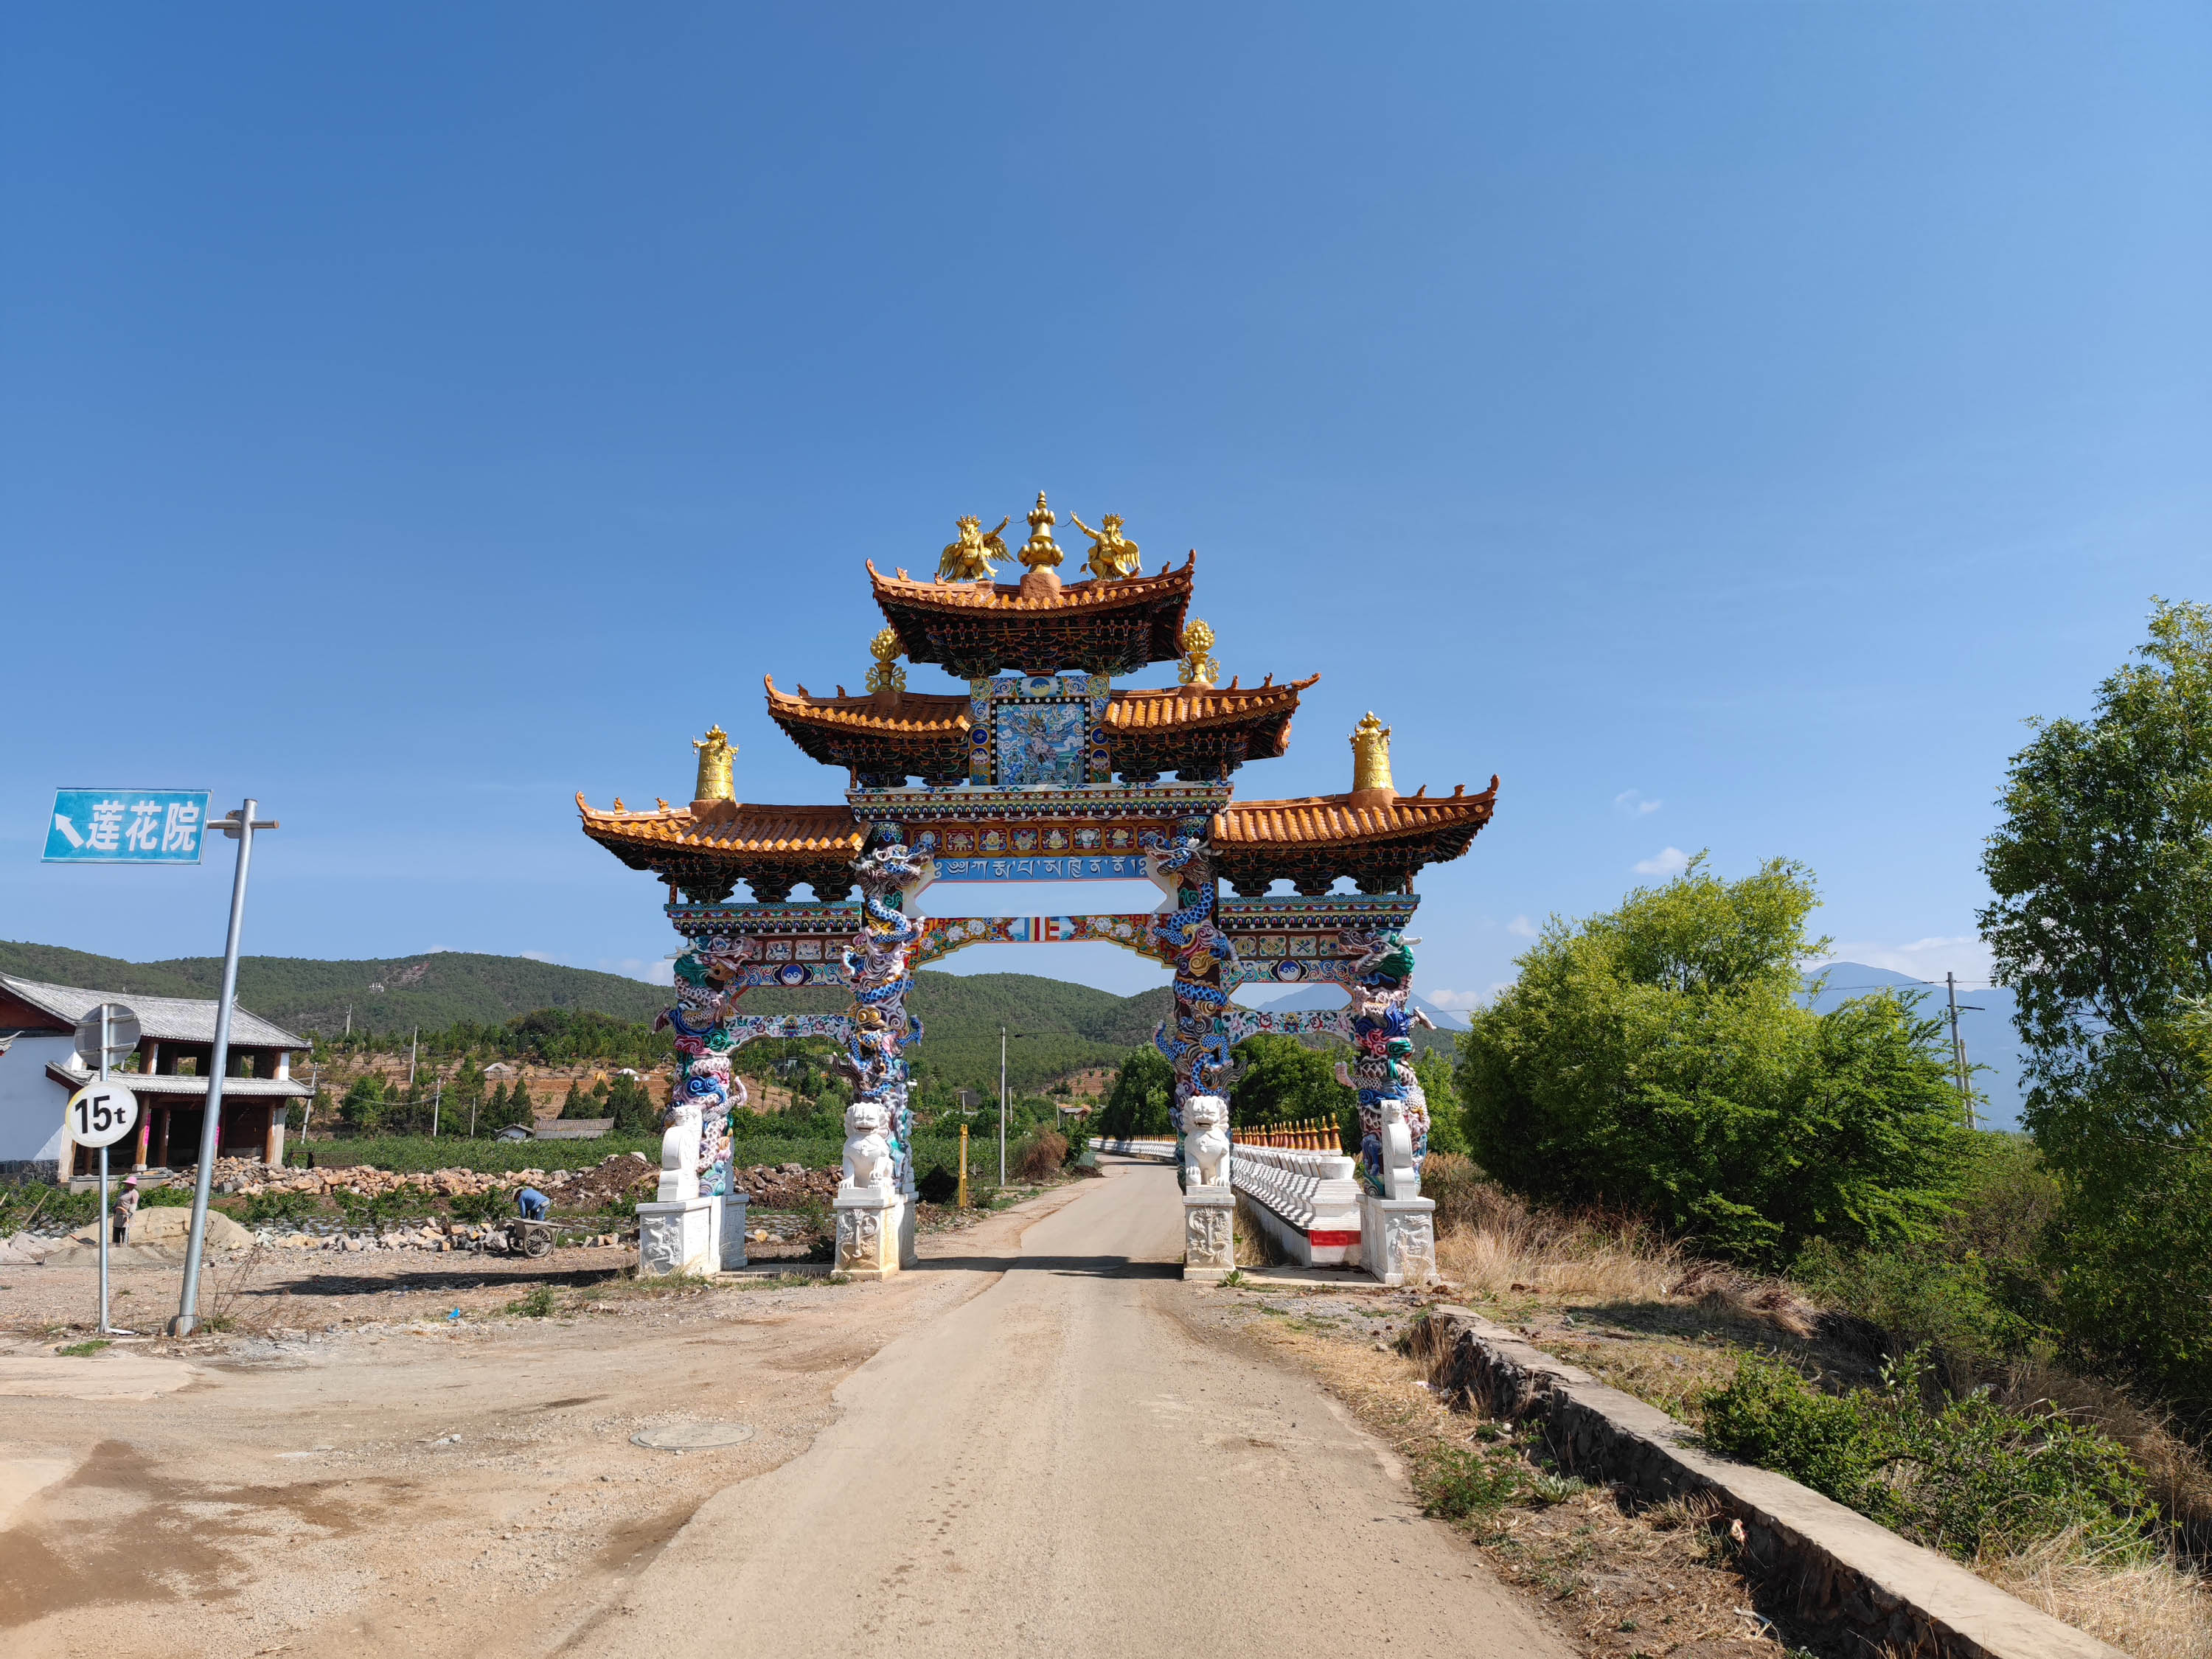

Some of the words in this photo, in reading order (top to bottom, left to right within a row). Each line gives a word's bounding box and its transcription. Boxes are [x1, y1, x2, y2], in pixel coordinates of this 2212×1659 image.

[87, 801, 199, 852] 莲花院
[75, 1096, 125, 1133] 15t
